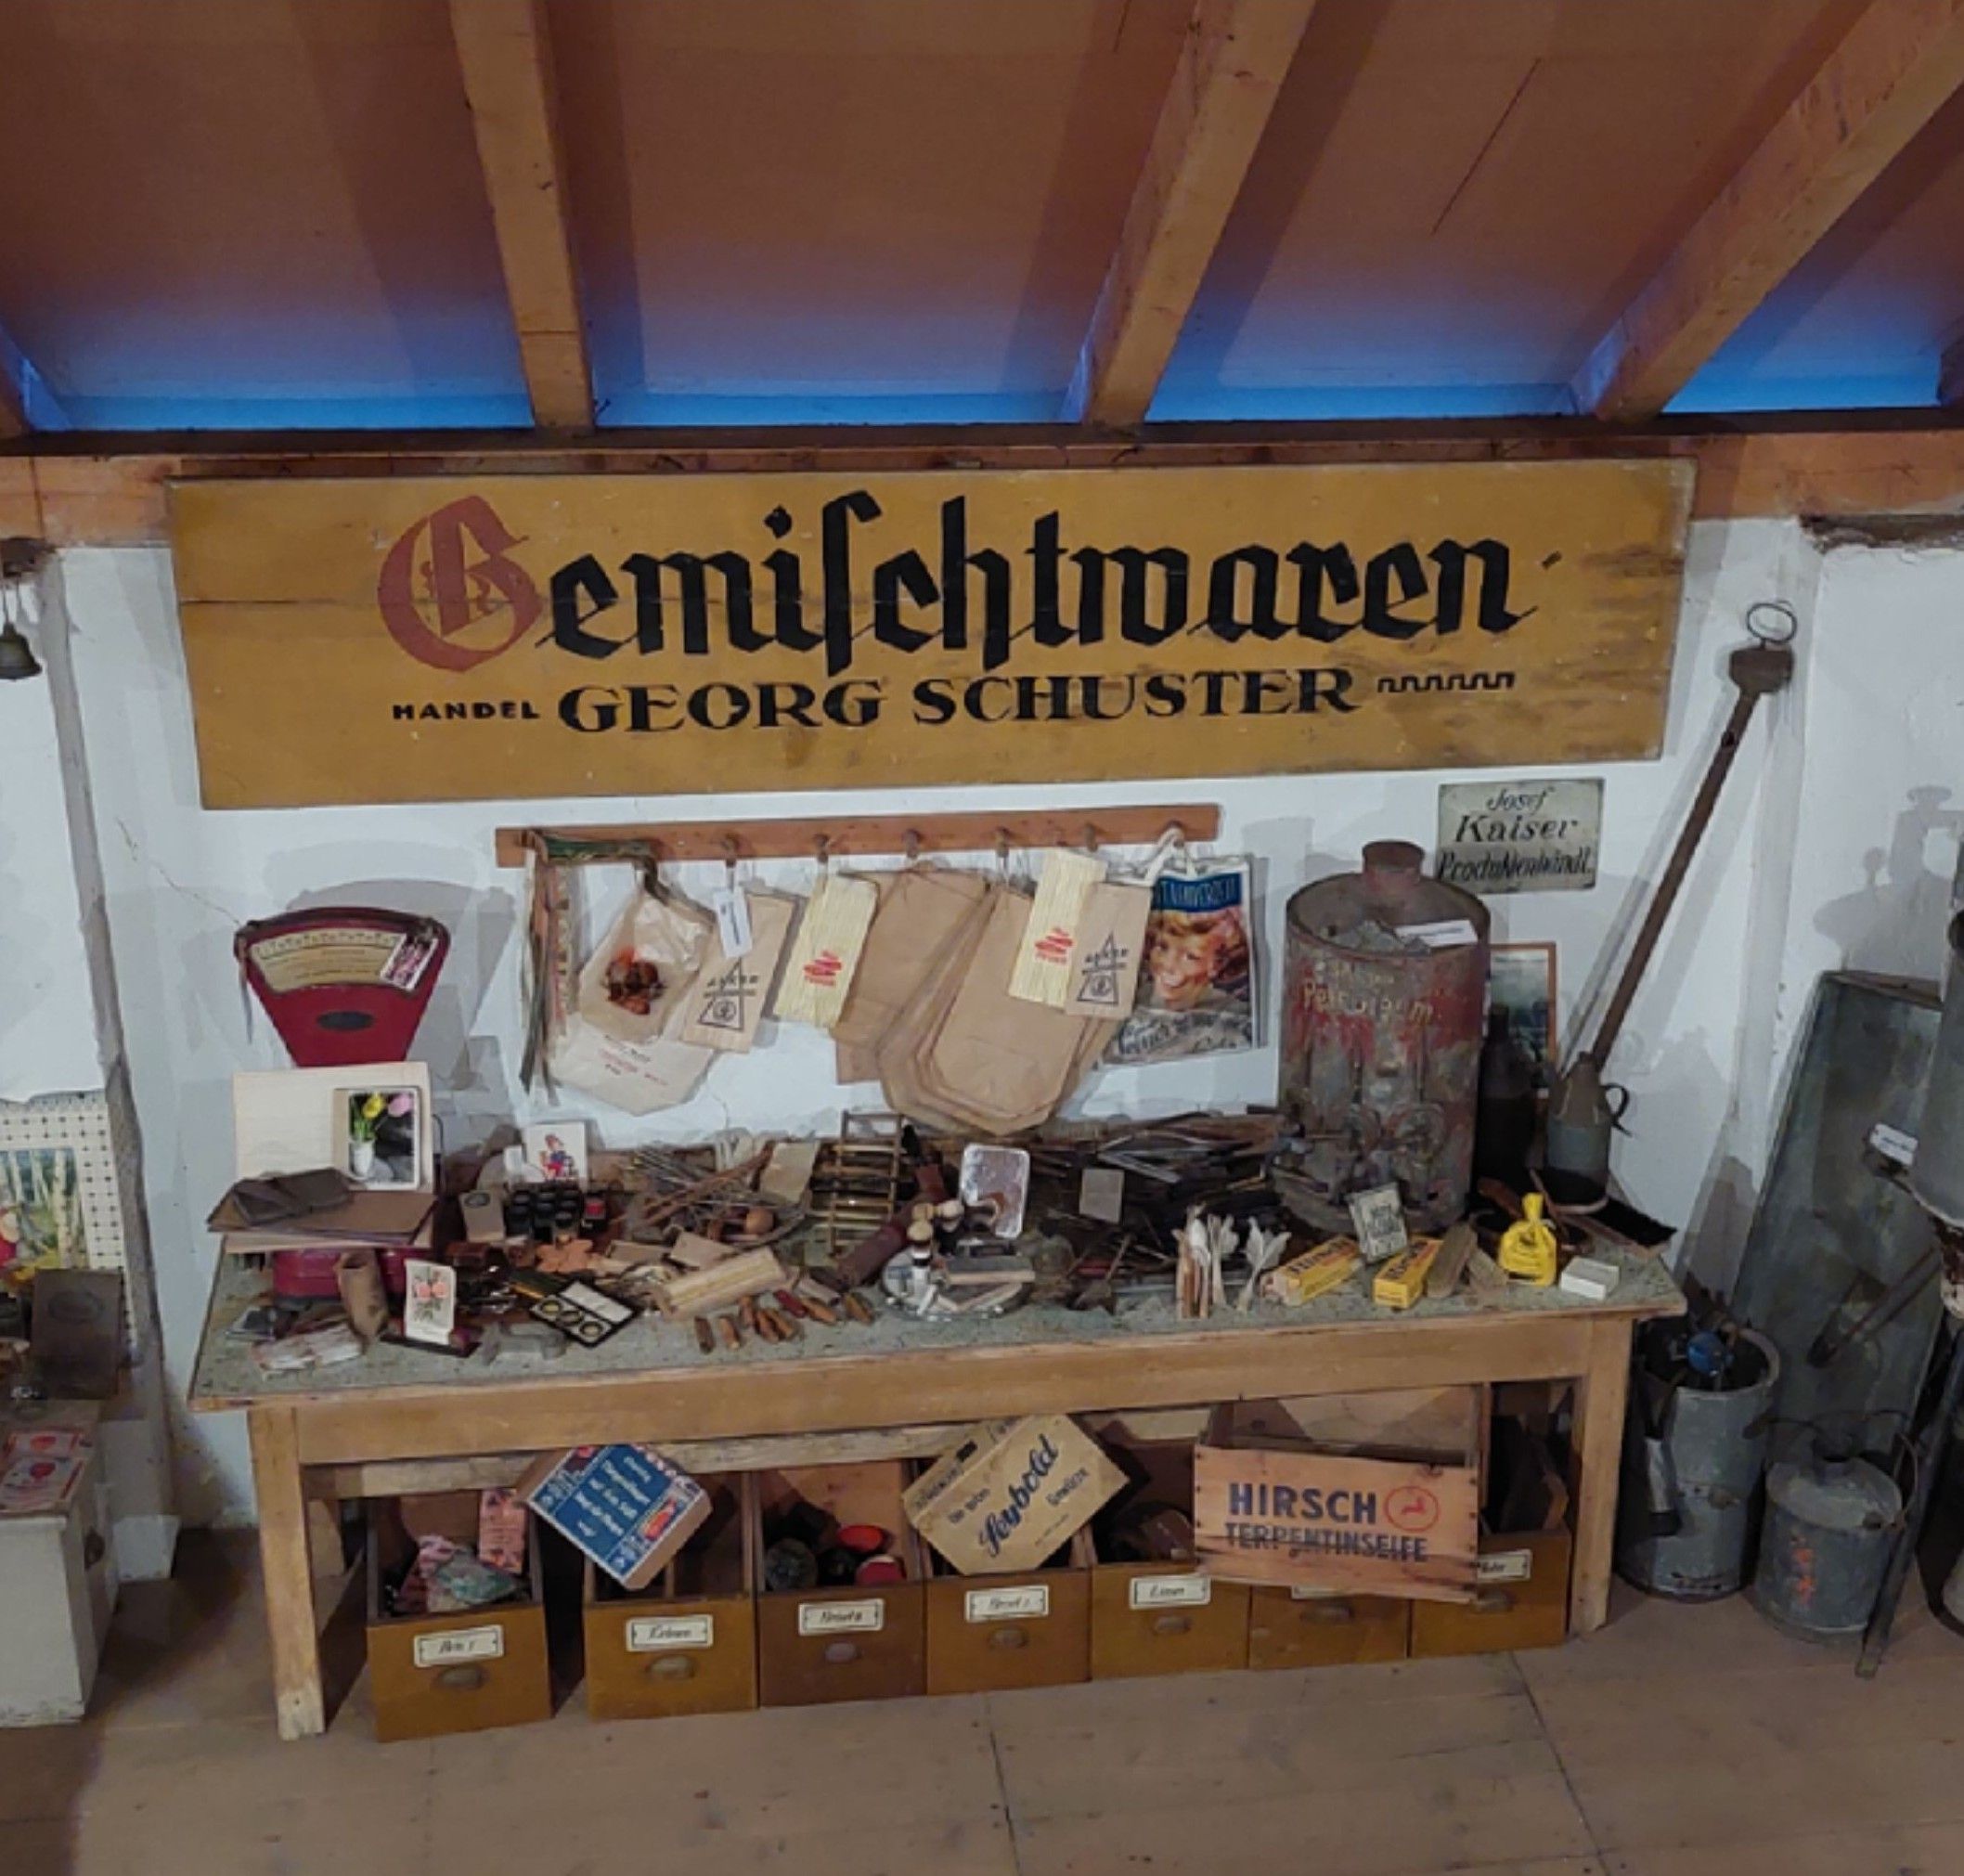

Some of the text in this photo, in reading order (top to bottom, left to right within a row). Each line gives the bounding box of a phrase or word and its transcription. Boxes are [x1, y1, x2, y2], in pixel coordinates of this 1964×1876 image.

[392, 667, 1363, 733] HANDEL GEORG SCHUSTER
[1455, 814, 1580, 843] Kaiser
[1229, 1482, 1376, 1524] HIRSCH
[1225, 1521, 1429, 1563] TERPENTINSEIFE
